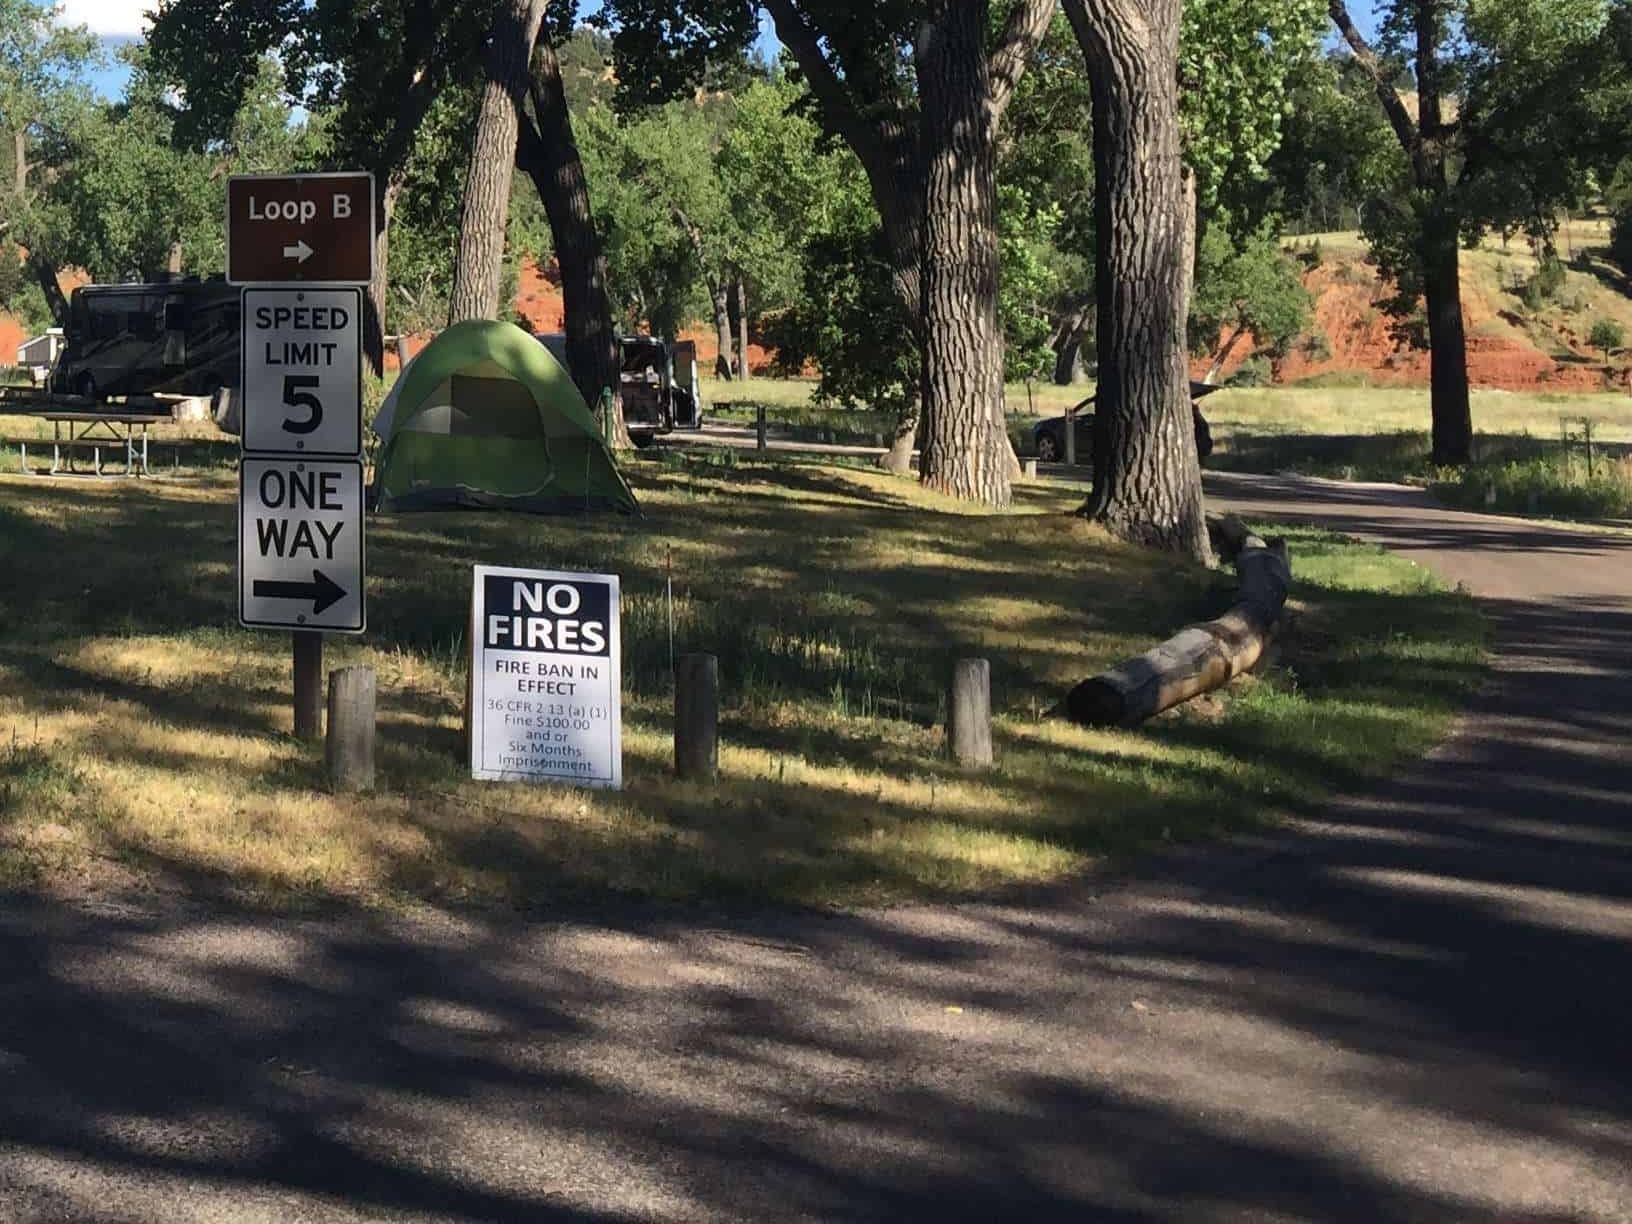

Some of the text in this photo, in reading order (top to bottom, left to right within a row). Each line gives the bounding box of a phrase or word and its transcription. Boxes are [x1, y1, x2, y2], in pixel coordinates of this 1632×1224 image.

[249, 194, 351, 223] Loop B
[256, 307, 348, 330] SPEED
[266, 344, 337, 366] LIMIT
[281, 376, 323, 434] 5
[260, 469, 343, 511] ONE
[256, 519, 344, 559] WAY
[513, 582, 580, 615] NO
[489, 615, 605, 652] FIRES
[496, 660, 598, 679] FIRE BAN IN
[518, 680, 576, 696] EFFECT
[488, 699, 607, 719] 36 CFR 213 (a) (1)
[505, 715, 590, 730] Fine $100.00
[526, 730, 550, 741] and
[509, 740, 581, 757] Six Months
[499, 755, 592, 771] Imprisonment
